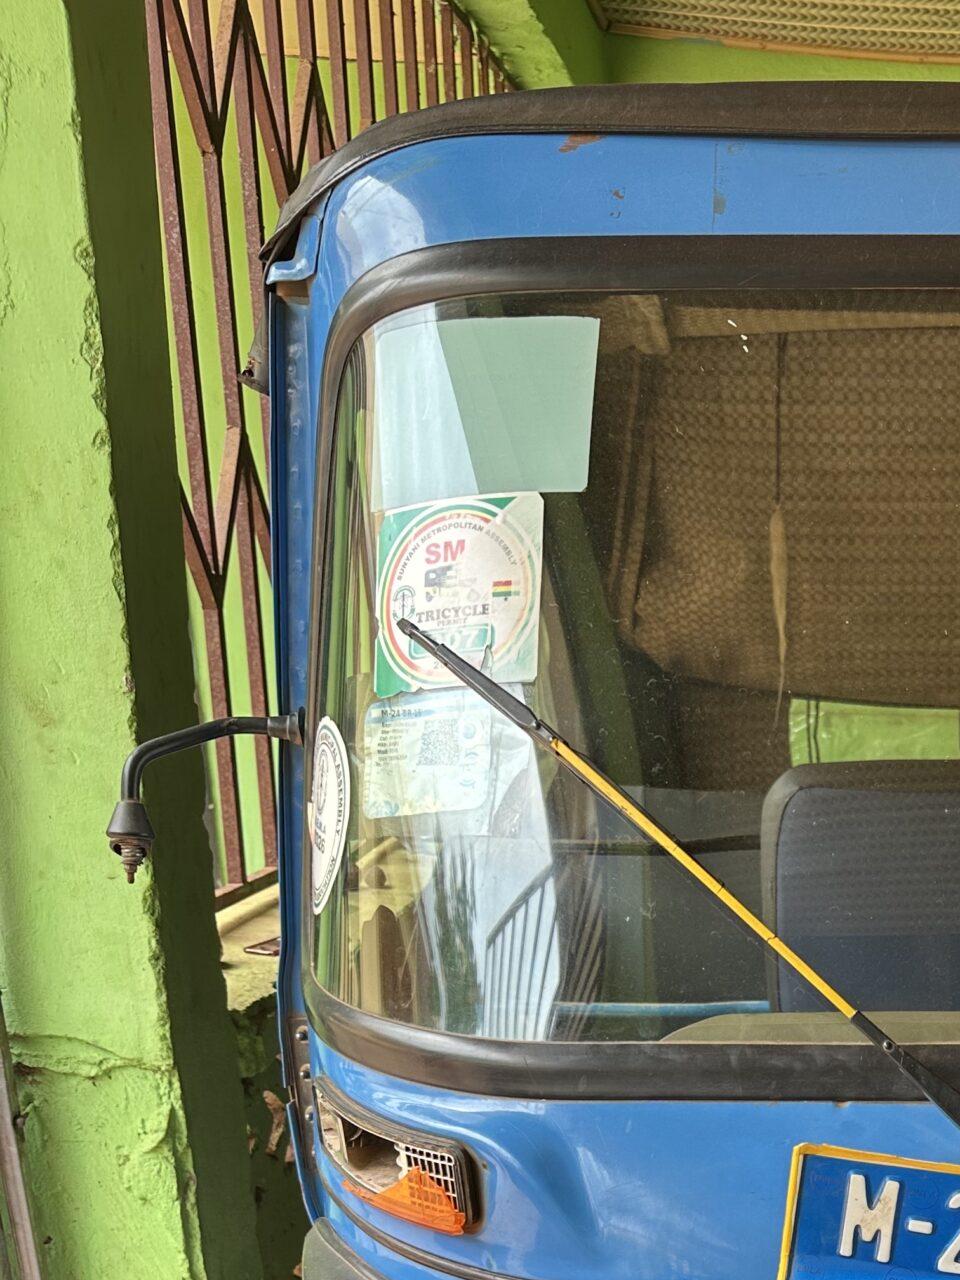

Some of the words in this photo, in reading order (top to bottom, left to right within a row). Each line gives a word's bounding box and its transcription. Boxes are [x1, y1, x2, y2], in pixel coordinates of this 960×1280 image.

[397, 542, 420, 580] SUNYANI
[421, 522, 484, 543] METROPOLITAN
[485, 529, 517, 566] ASSEMBLY
[416, 603, 489, 623] TRICYCLE
